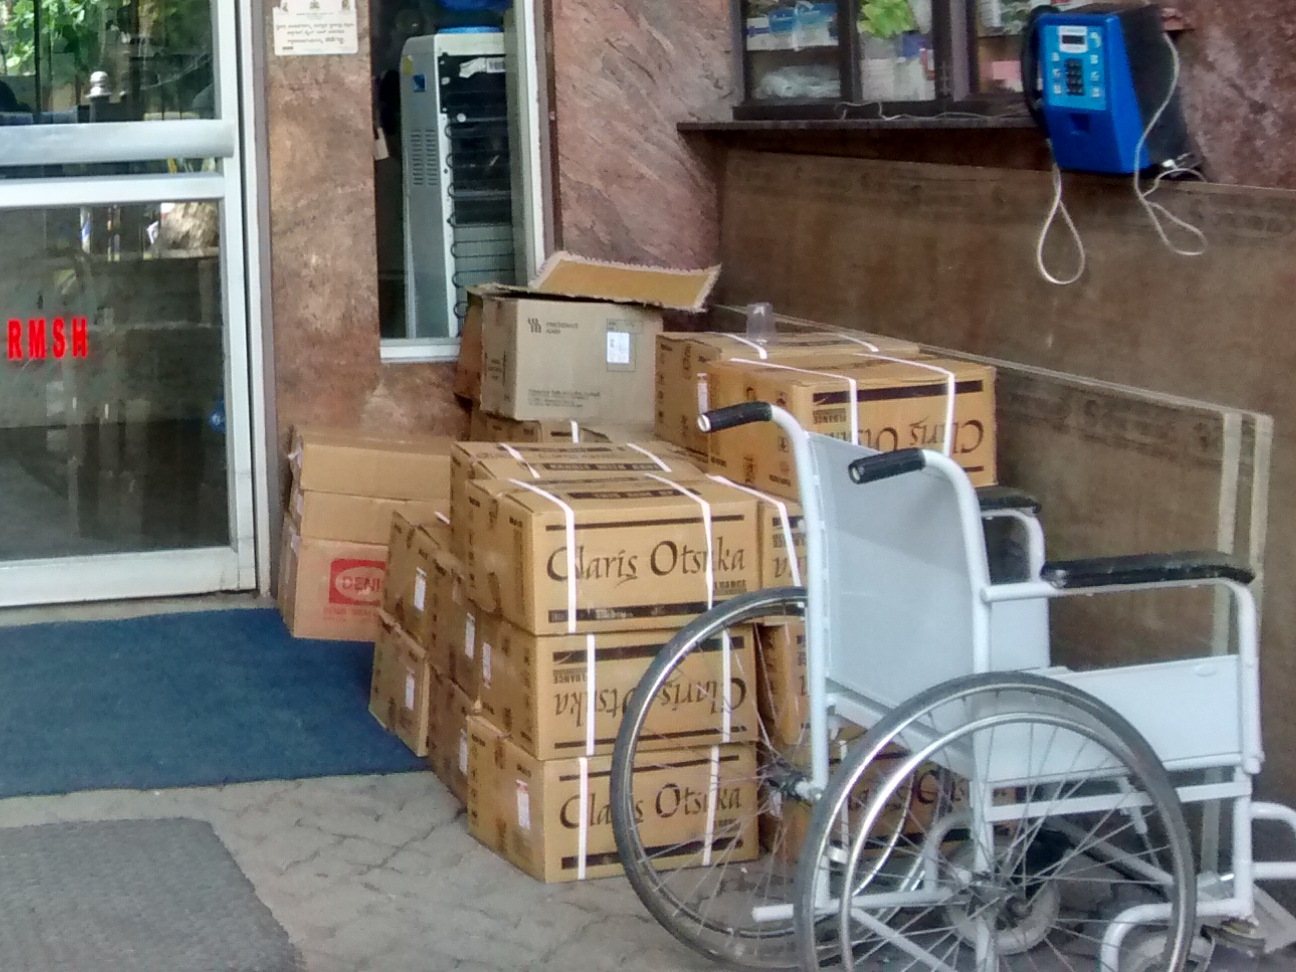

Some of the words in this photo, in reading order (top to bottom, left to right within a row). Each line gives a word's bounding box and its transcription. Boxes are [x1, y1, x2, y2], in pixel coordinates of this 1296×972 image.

[7, 316, 88, 362] RMSH
[650, 536, 746, 576] Otska
[342, 576, 383, 593] DENI
[559, 792, 644, 830] Clas
[655, 777, 743, 818] Otska
